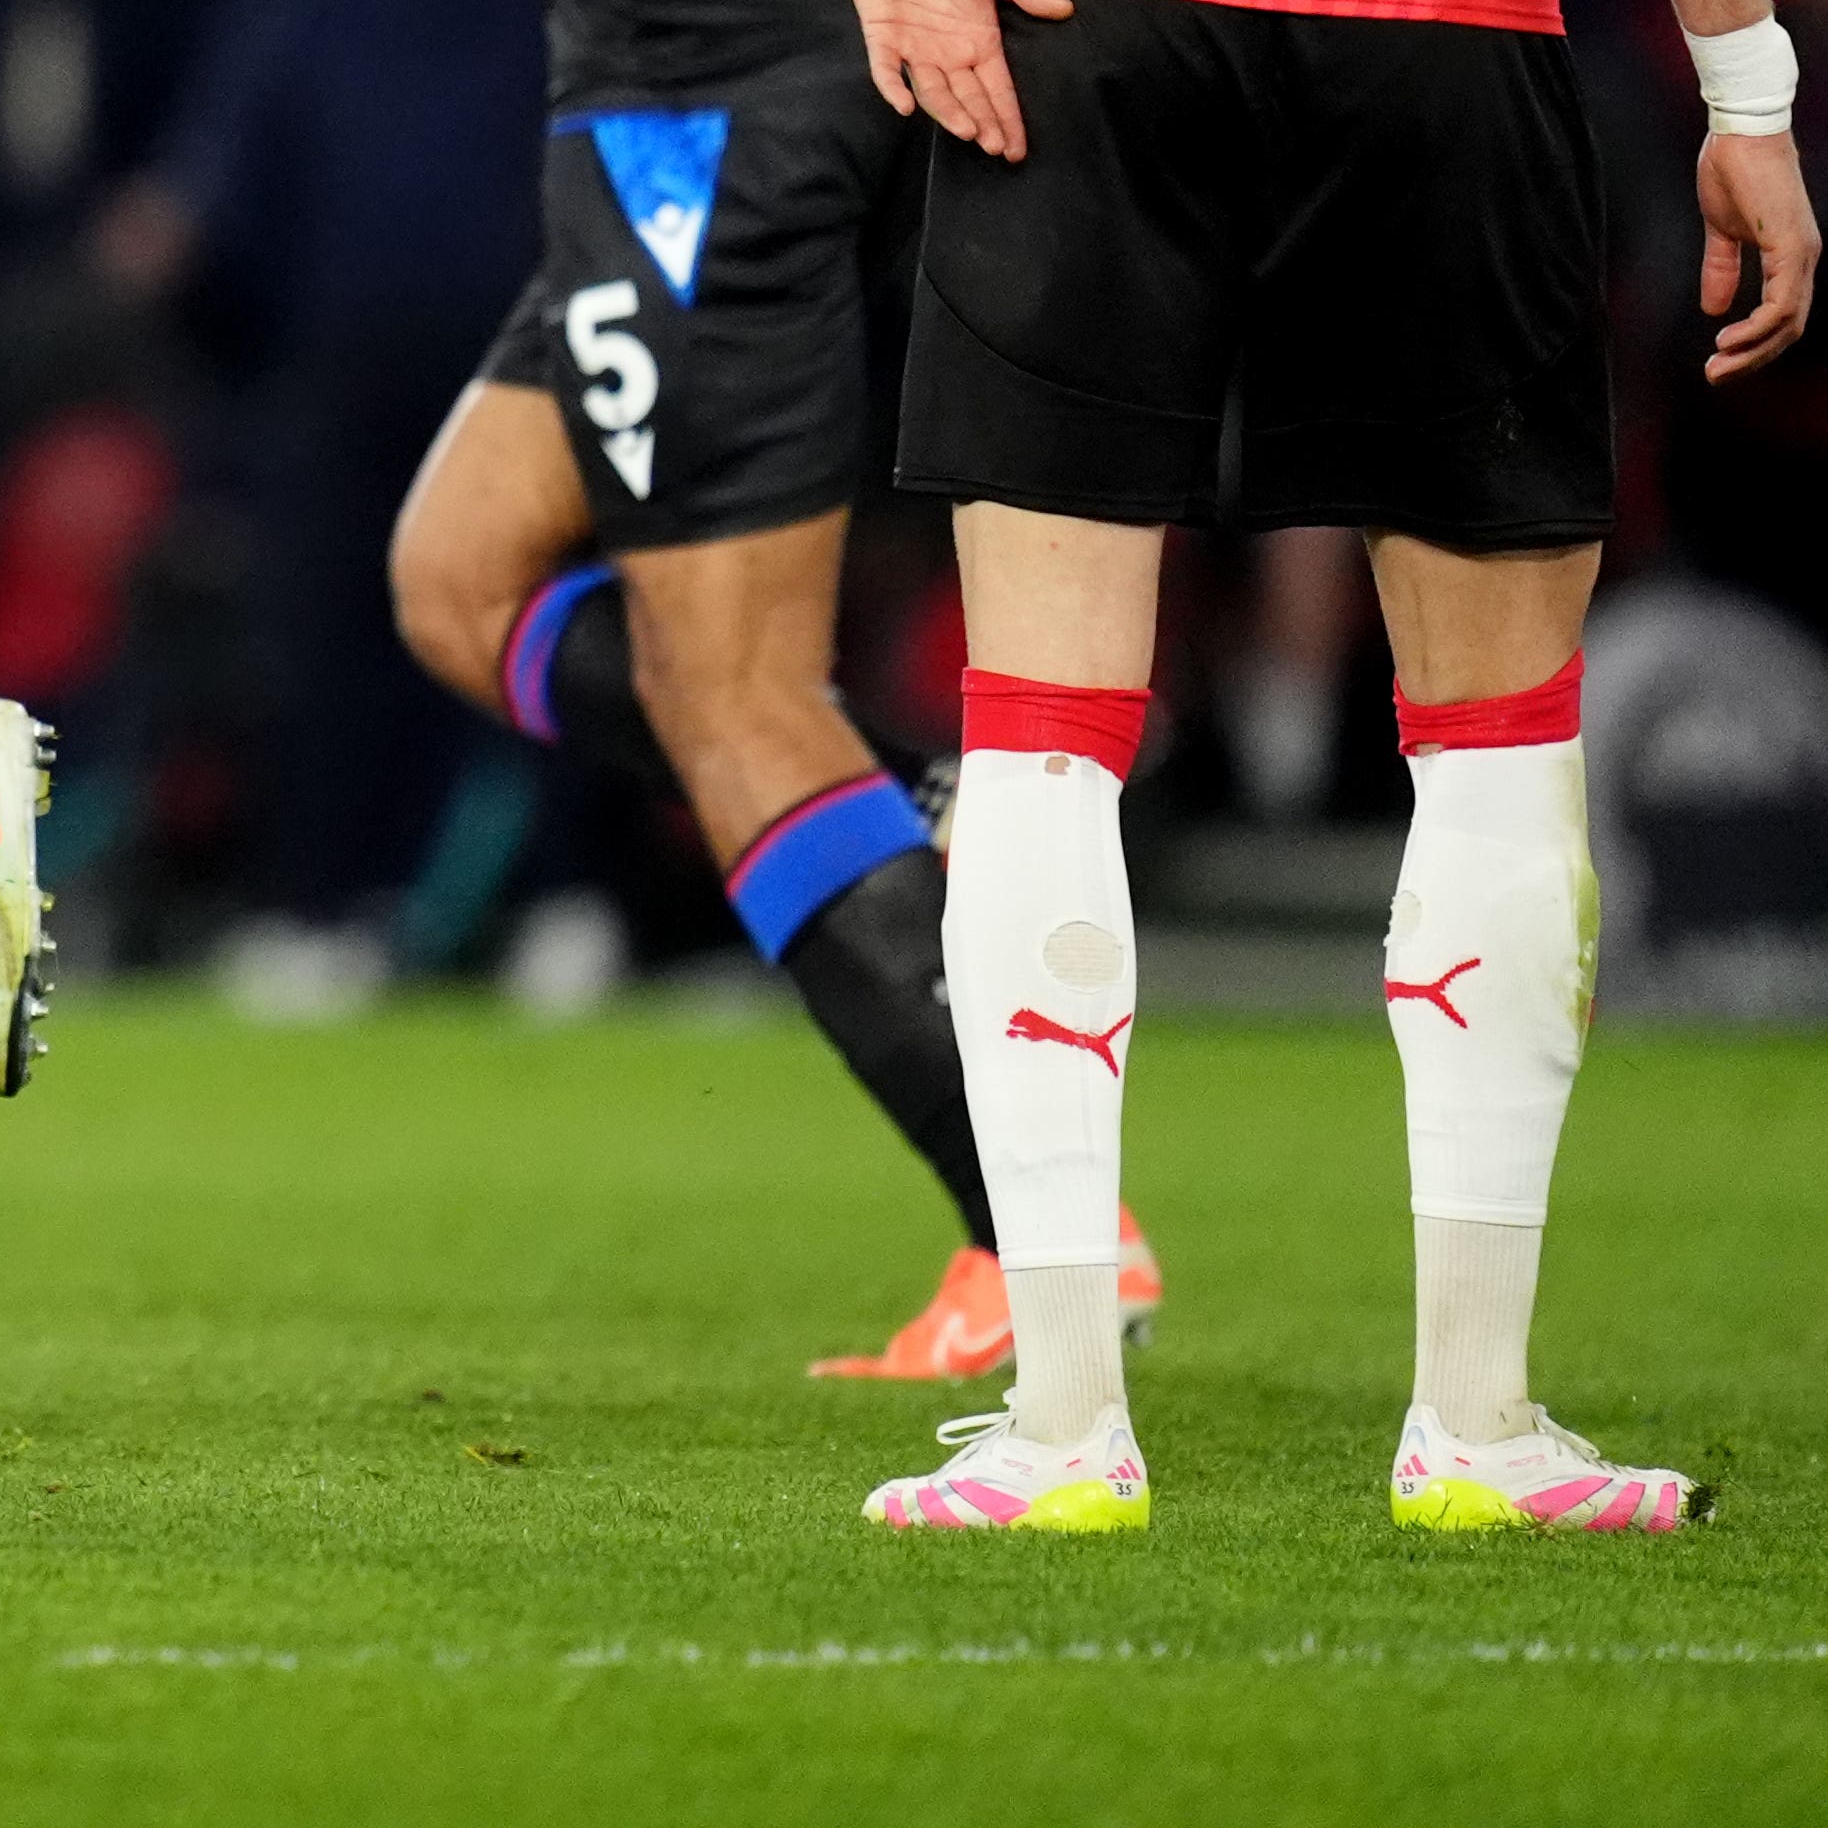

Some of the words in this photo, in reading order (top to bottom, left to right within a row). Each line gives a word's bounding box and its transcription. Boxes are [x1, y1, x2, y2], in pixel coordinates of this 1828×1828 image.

[565, 279, 660, 431] 5
[1115, 1482, 1132, 1496] 35
[1401, 1481, 1415, 1495] 35
